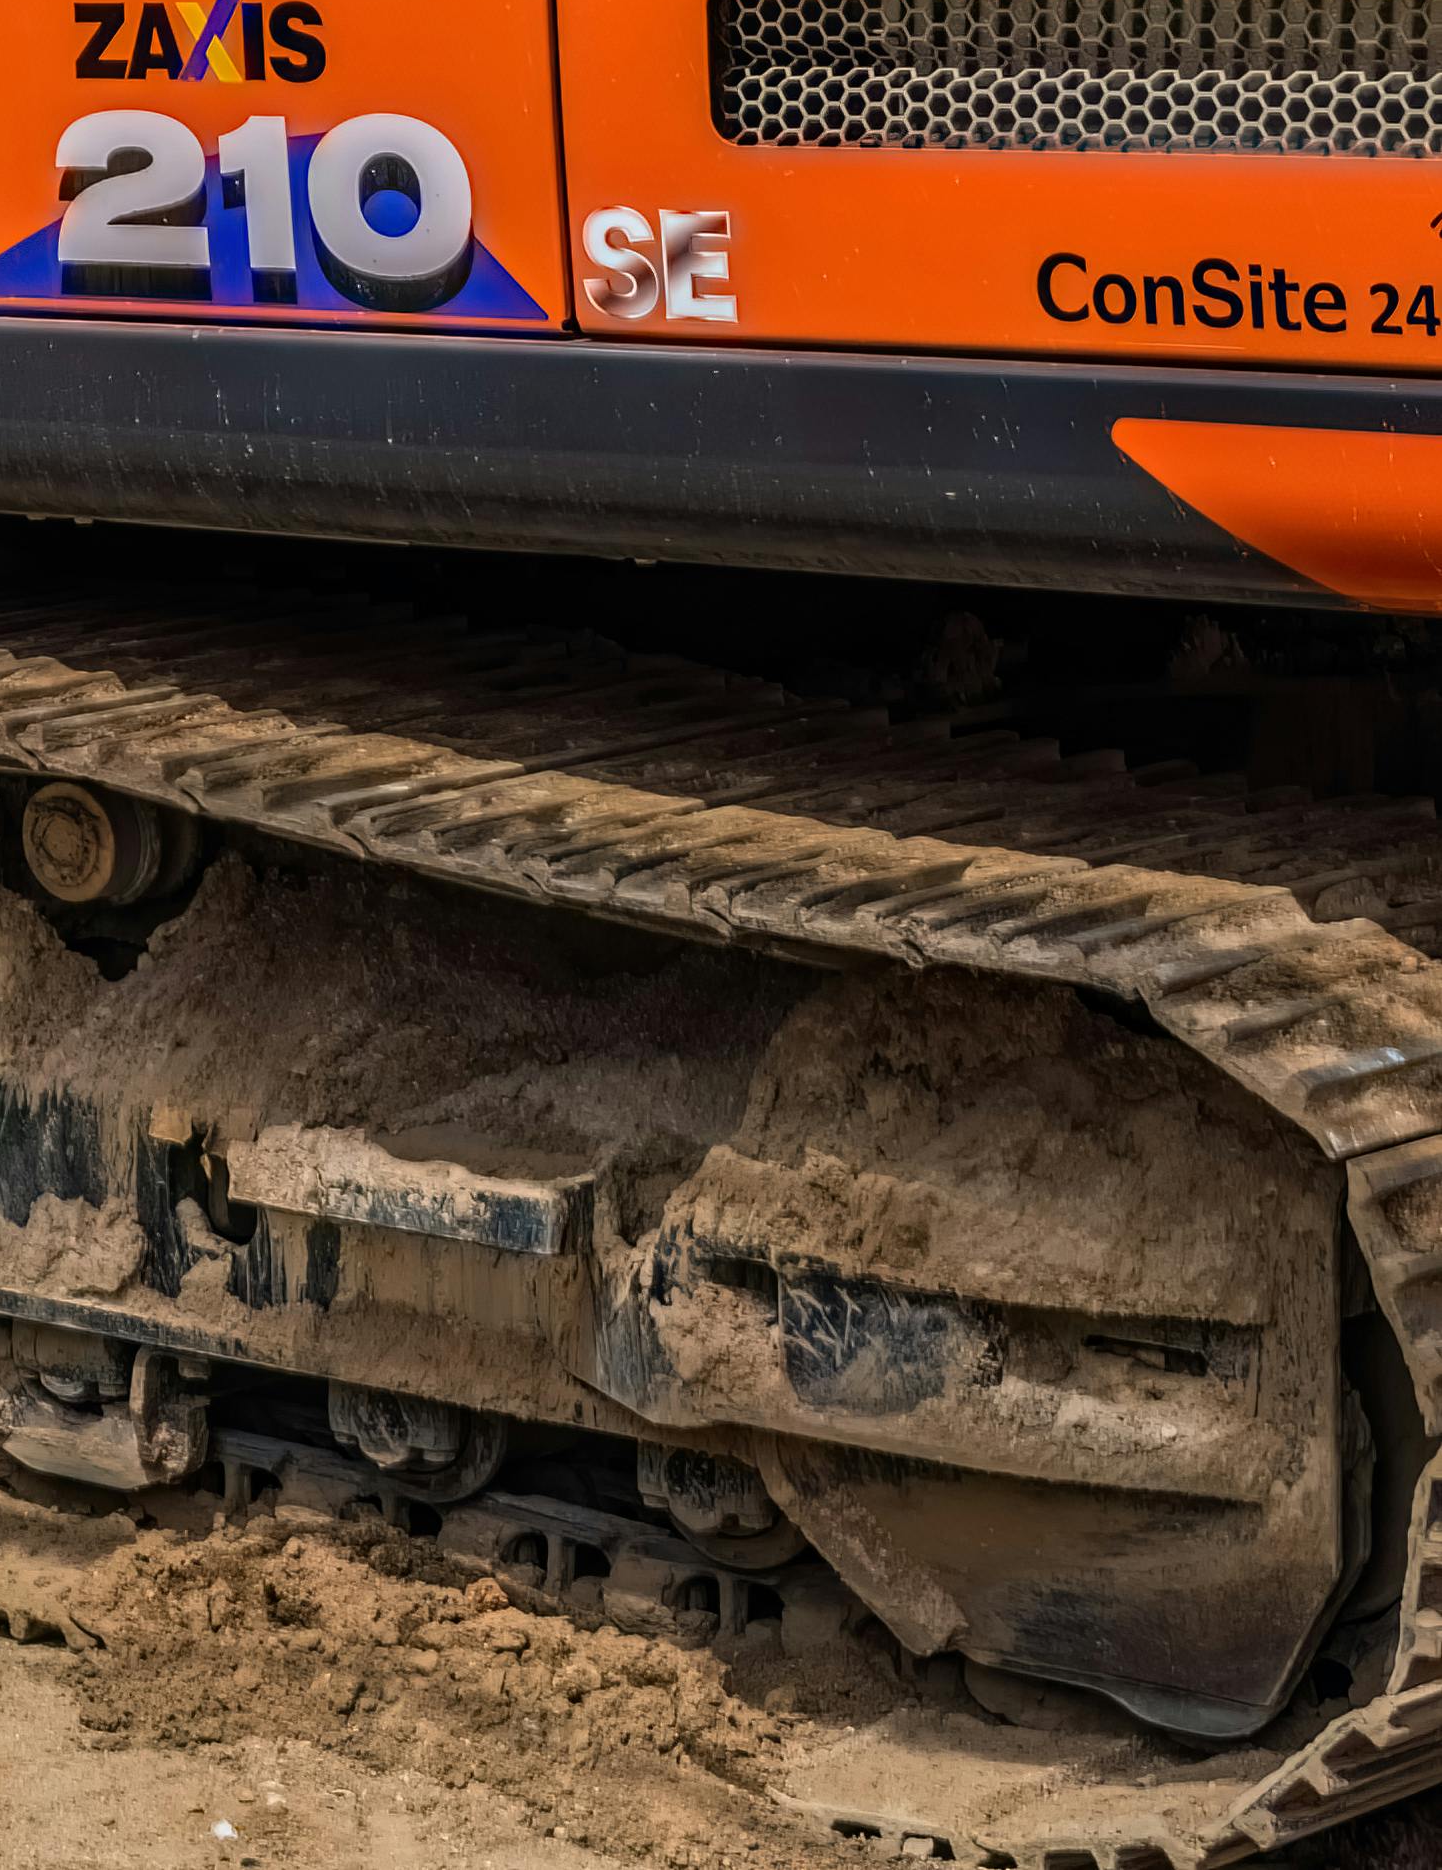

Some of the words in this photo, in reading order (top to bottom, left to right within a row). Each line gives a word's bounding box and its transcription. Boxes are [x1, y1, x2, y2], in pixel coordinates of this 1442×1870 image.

[55, 109, 475, 308] 210
[582, 205, 738, 323] SE
[1036, 251, 1348, 333] ConSite
